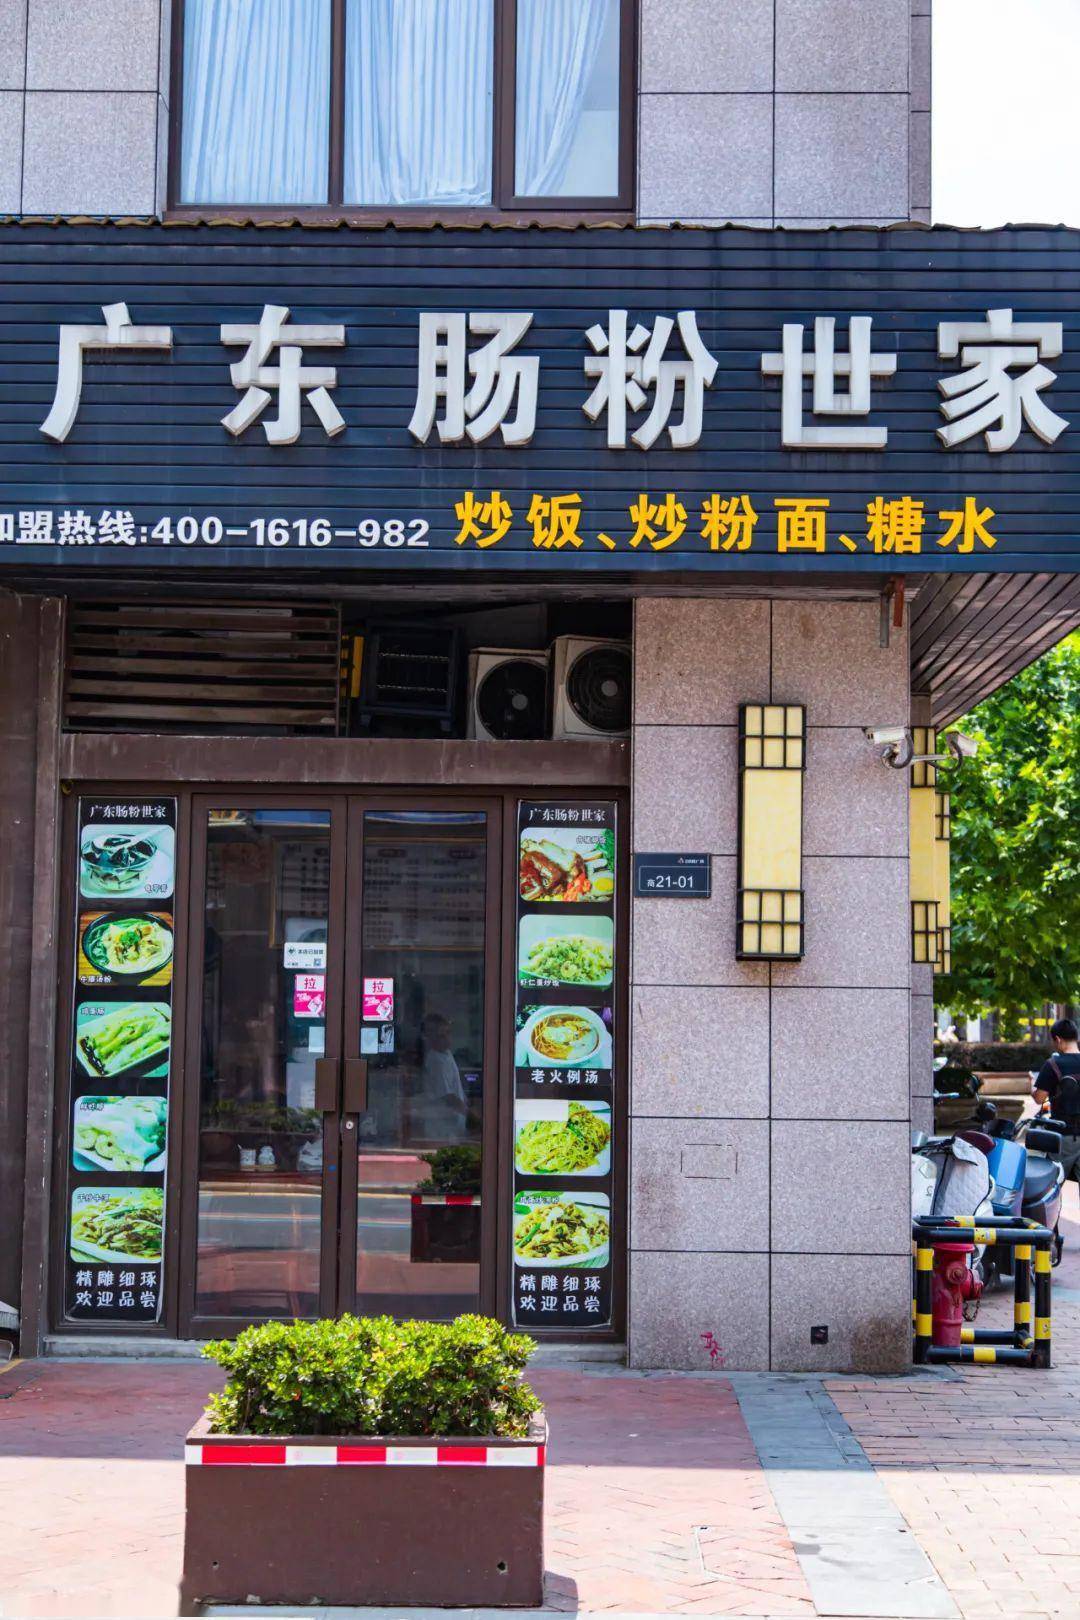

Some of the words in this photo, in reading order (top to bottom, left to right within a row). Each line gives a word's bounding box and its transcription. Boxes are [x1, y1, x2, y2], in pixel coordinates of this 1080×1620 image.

[39, 302, 1070, 452] 广东肠粉世家
[454, 491, 998, 554] 炒饭、炒粉面、糖水
[89, 805, 168, 819] 广东肠粉世家
[528, 808, 606, 822] 广东肠粉世家
[304, 977, 317, 990] 拉
[372, 981, 384, 993] 拉
[531, 1069, 598, 1084] 老火例汤
[76, 1270, 157, 1287] 精雕细琢
[520, 1274, 601, 1292] 精雕细琢
[76, 1291, 156, 1308] 欢迎品尝
[520, 1295, 600, 1312] 欢迎品尝
